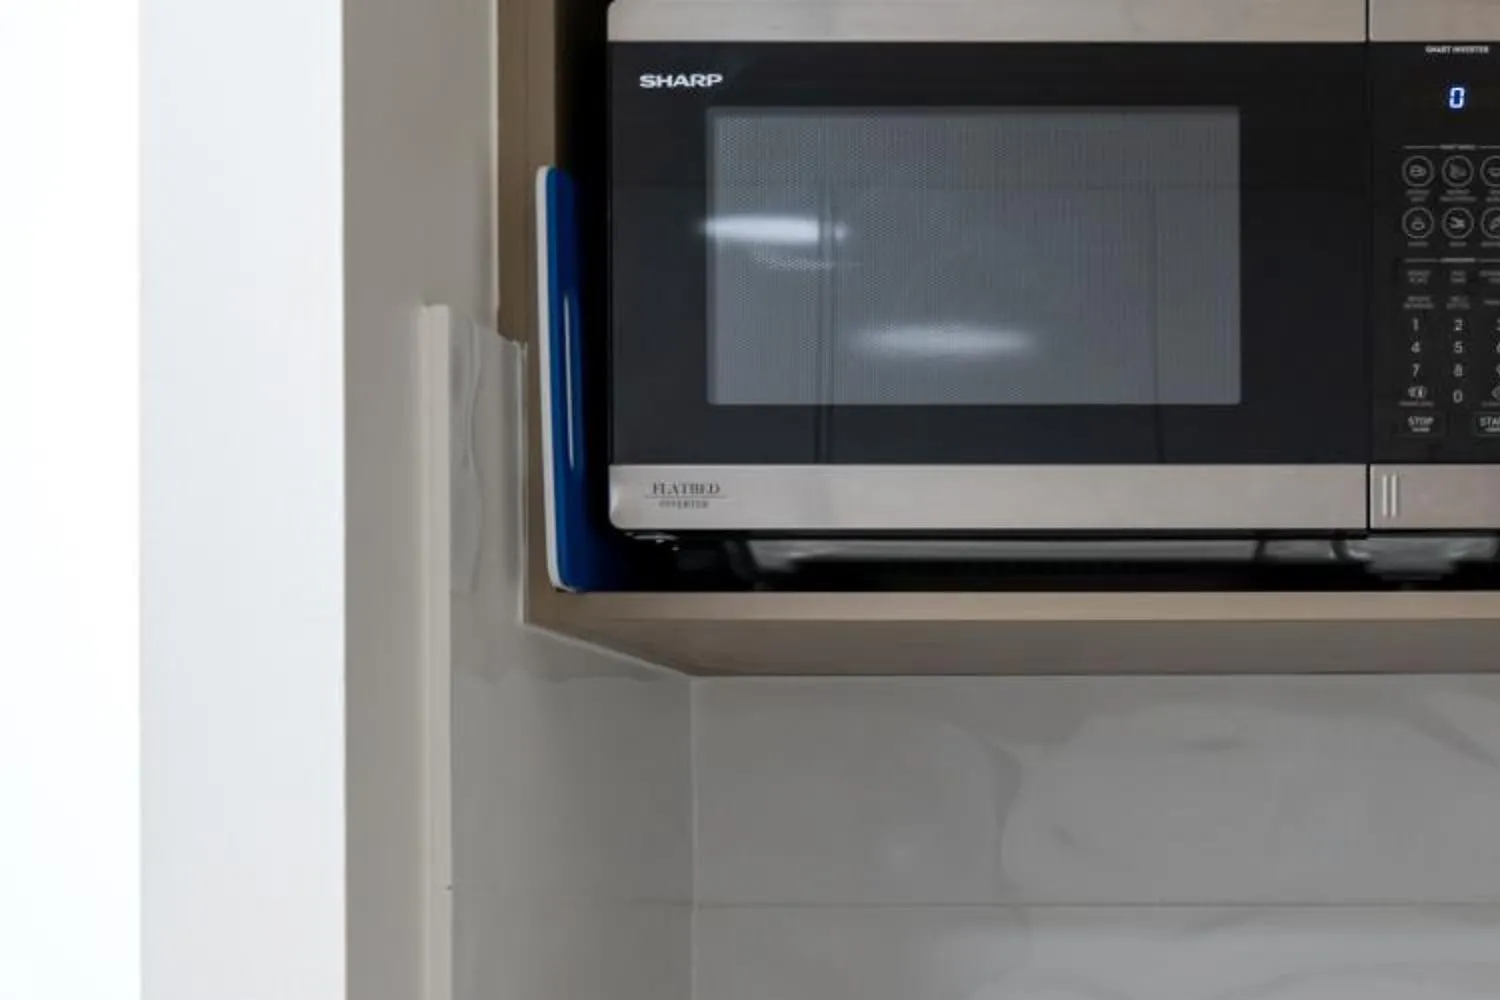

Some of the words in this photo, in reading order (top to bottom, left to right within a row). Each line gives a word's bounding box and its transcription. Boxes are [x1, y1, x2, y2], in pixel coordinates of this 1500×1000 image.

[639, 73, 723, 88] SHARP
[1449, 87, 1465, 108] 0
[1454, 318, 1463, 331] 2
[1454, 341, 1463, 353] 5
